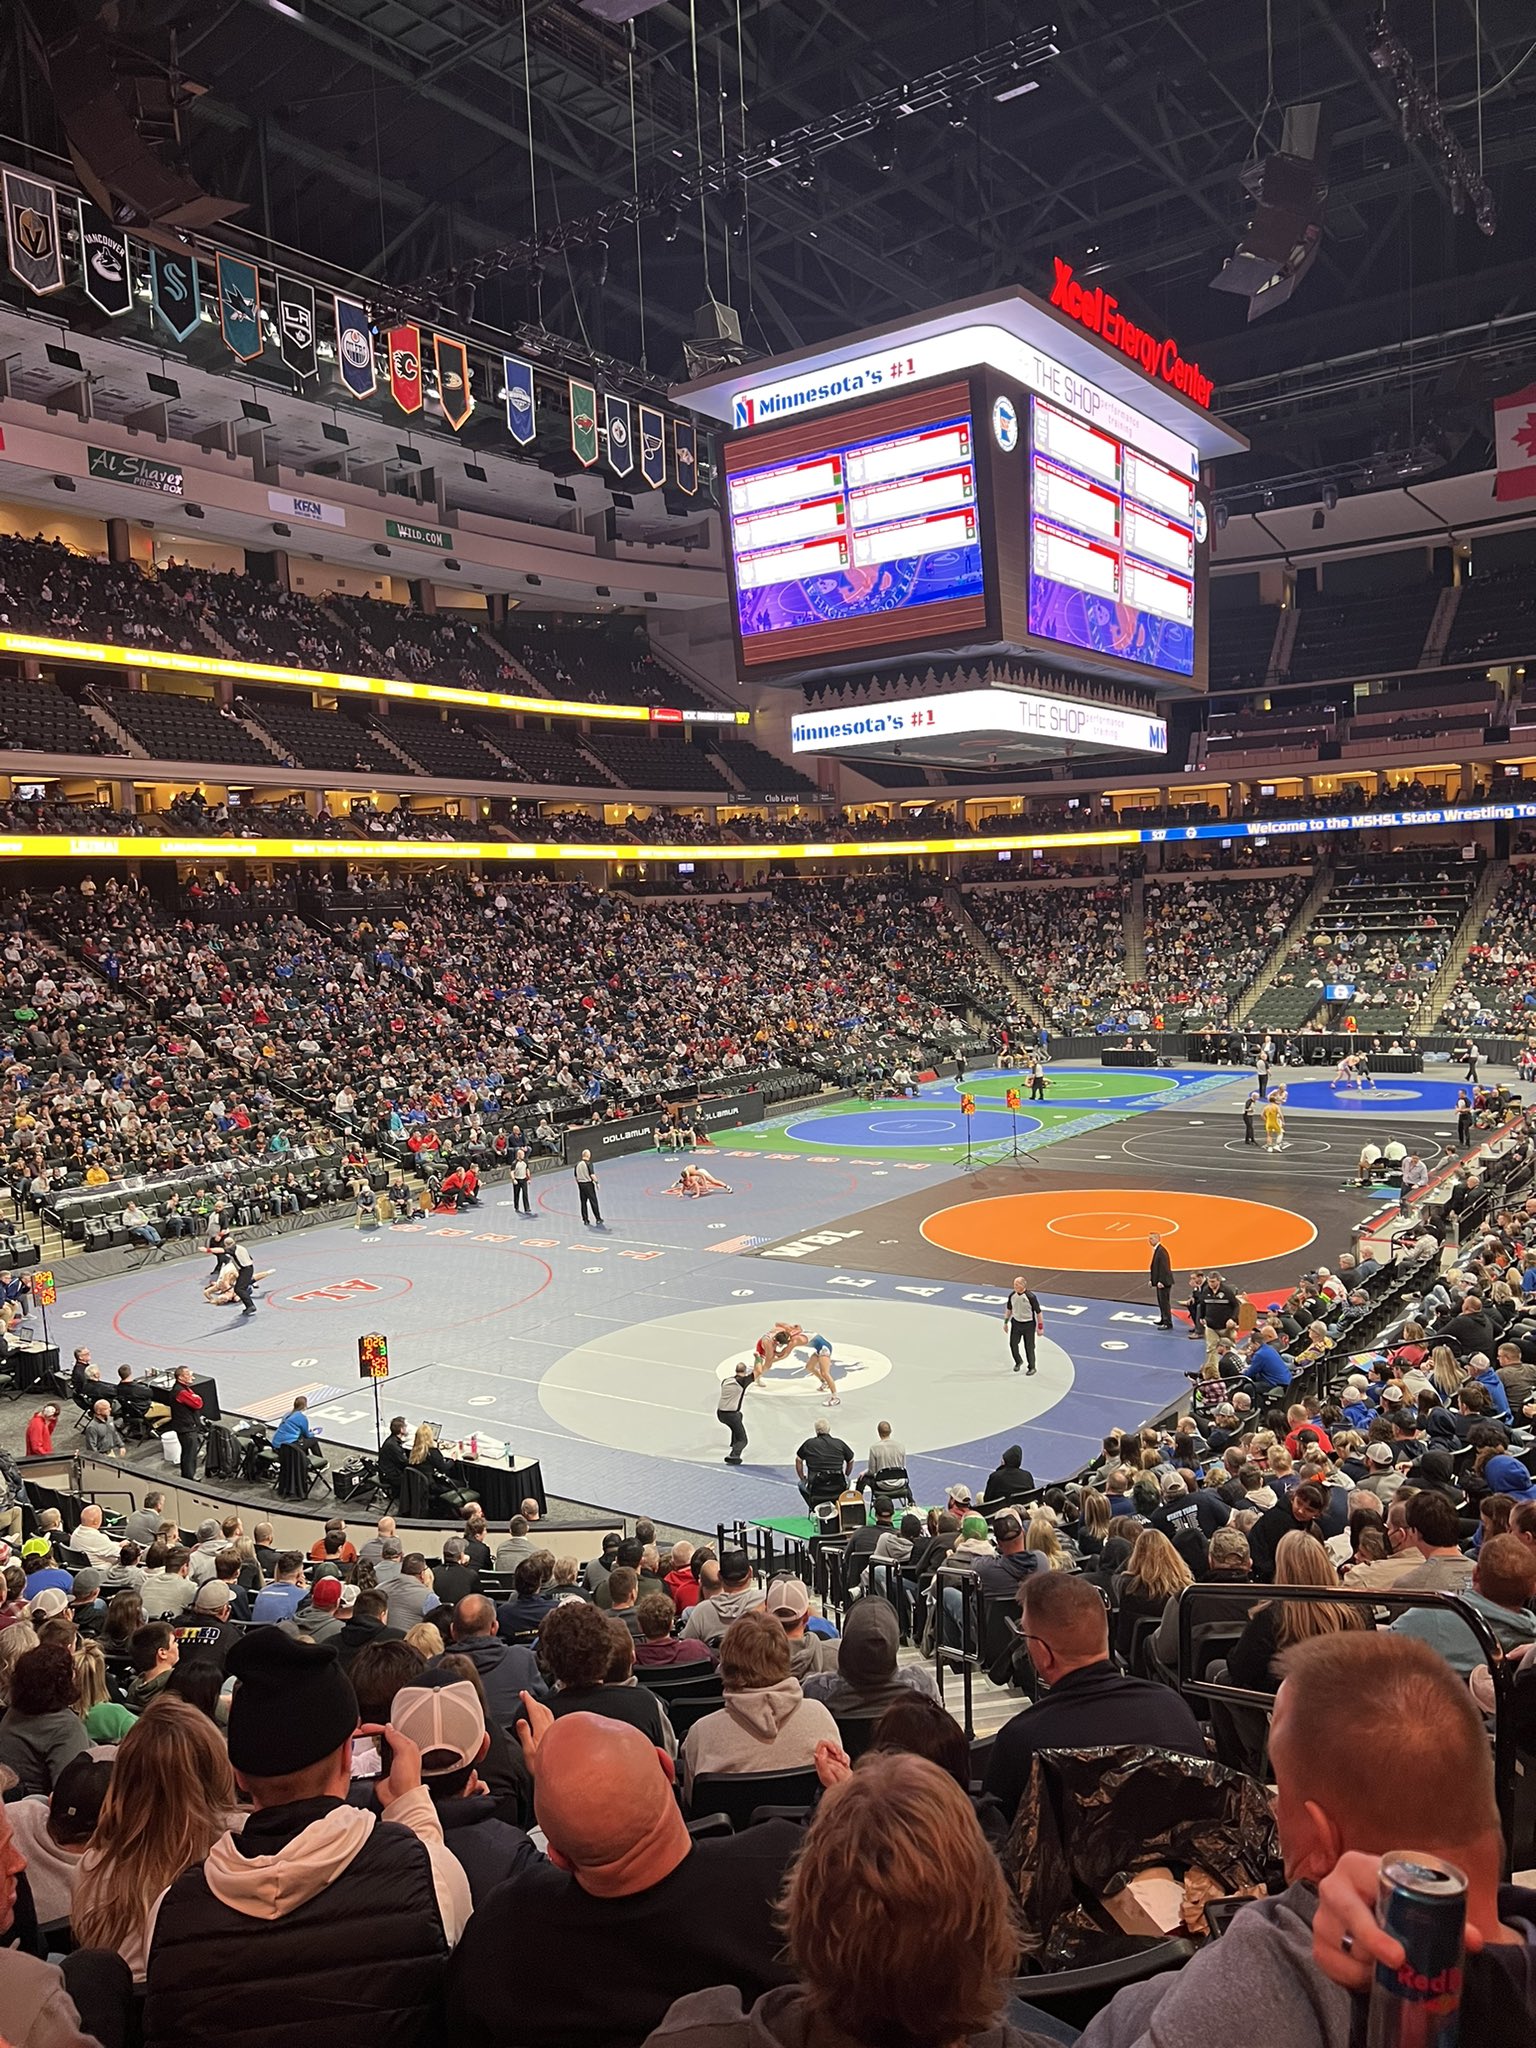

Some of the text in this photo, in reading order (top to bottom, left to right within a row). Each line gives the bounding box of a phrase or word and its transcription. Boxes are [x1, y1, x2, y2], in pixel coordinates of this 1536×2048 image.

[84, 233, 125, 257] VANCOUVER
[1051, 256, 1215, 408] Xcel Energy Center
[759, 370, 883, 416] Minnesota's
[889, 357, 916, 380] #1
[1033, 356, 1061, 397] THE
[1064, 375, 1101, 417] SHOP
[91, 450, 184, 486] Al Shaver
[133, 477, 183, 495] PRESS BOX
[910, 709, 936, 727] #1
[1019, 701, 1046, 729] THE
[1050, 706, 1085, 734] SHOP
[765, 794, 799, 803] Club Level
[1246, 822, 1308, 835] Welcome
[1310, 819, 1324, 832] to
[1326, 817, 1349, 829] the
[1351, 815, 1401, 828] MSHSL
[1402, 812, 1441, 824] State
[1443, 805, 1514, 821] Wrestling
[602, 1127, 651, 1145] DOLLAMUR
[759, 1229, 864, 1258] WBL
[379, 1346, 387, 1356] 3
